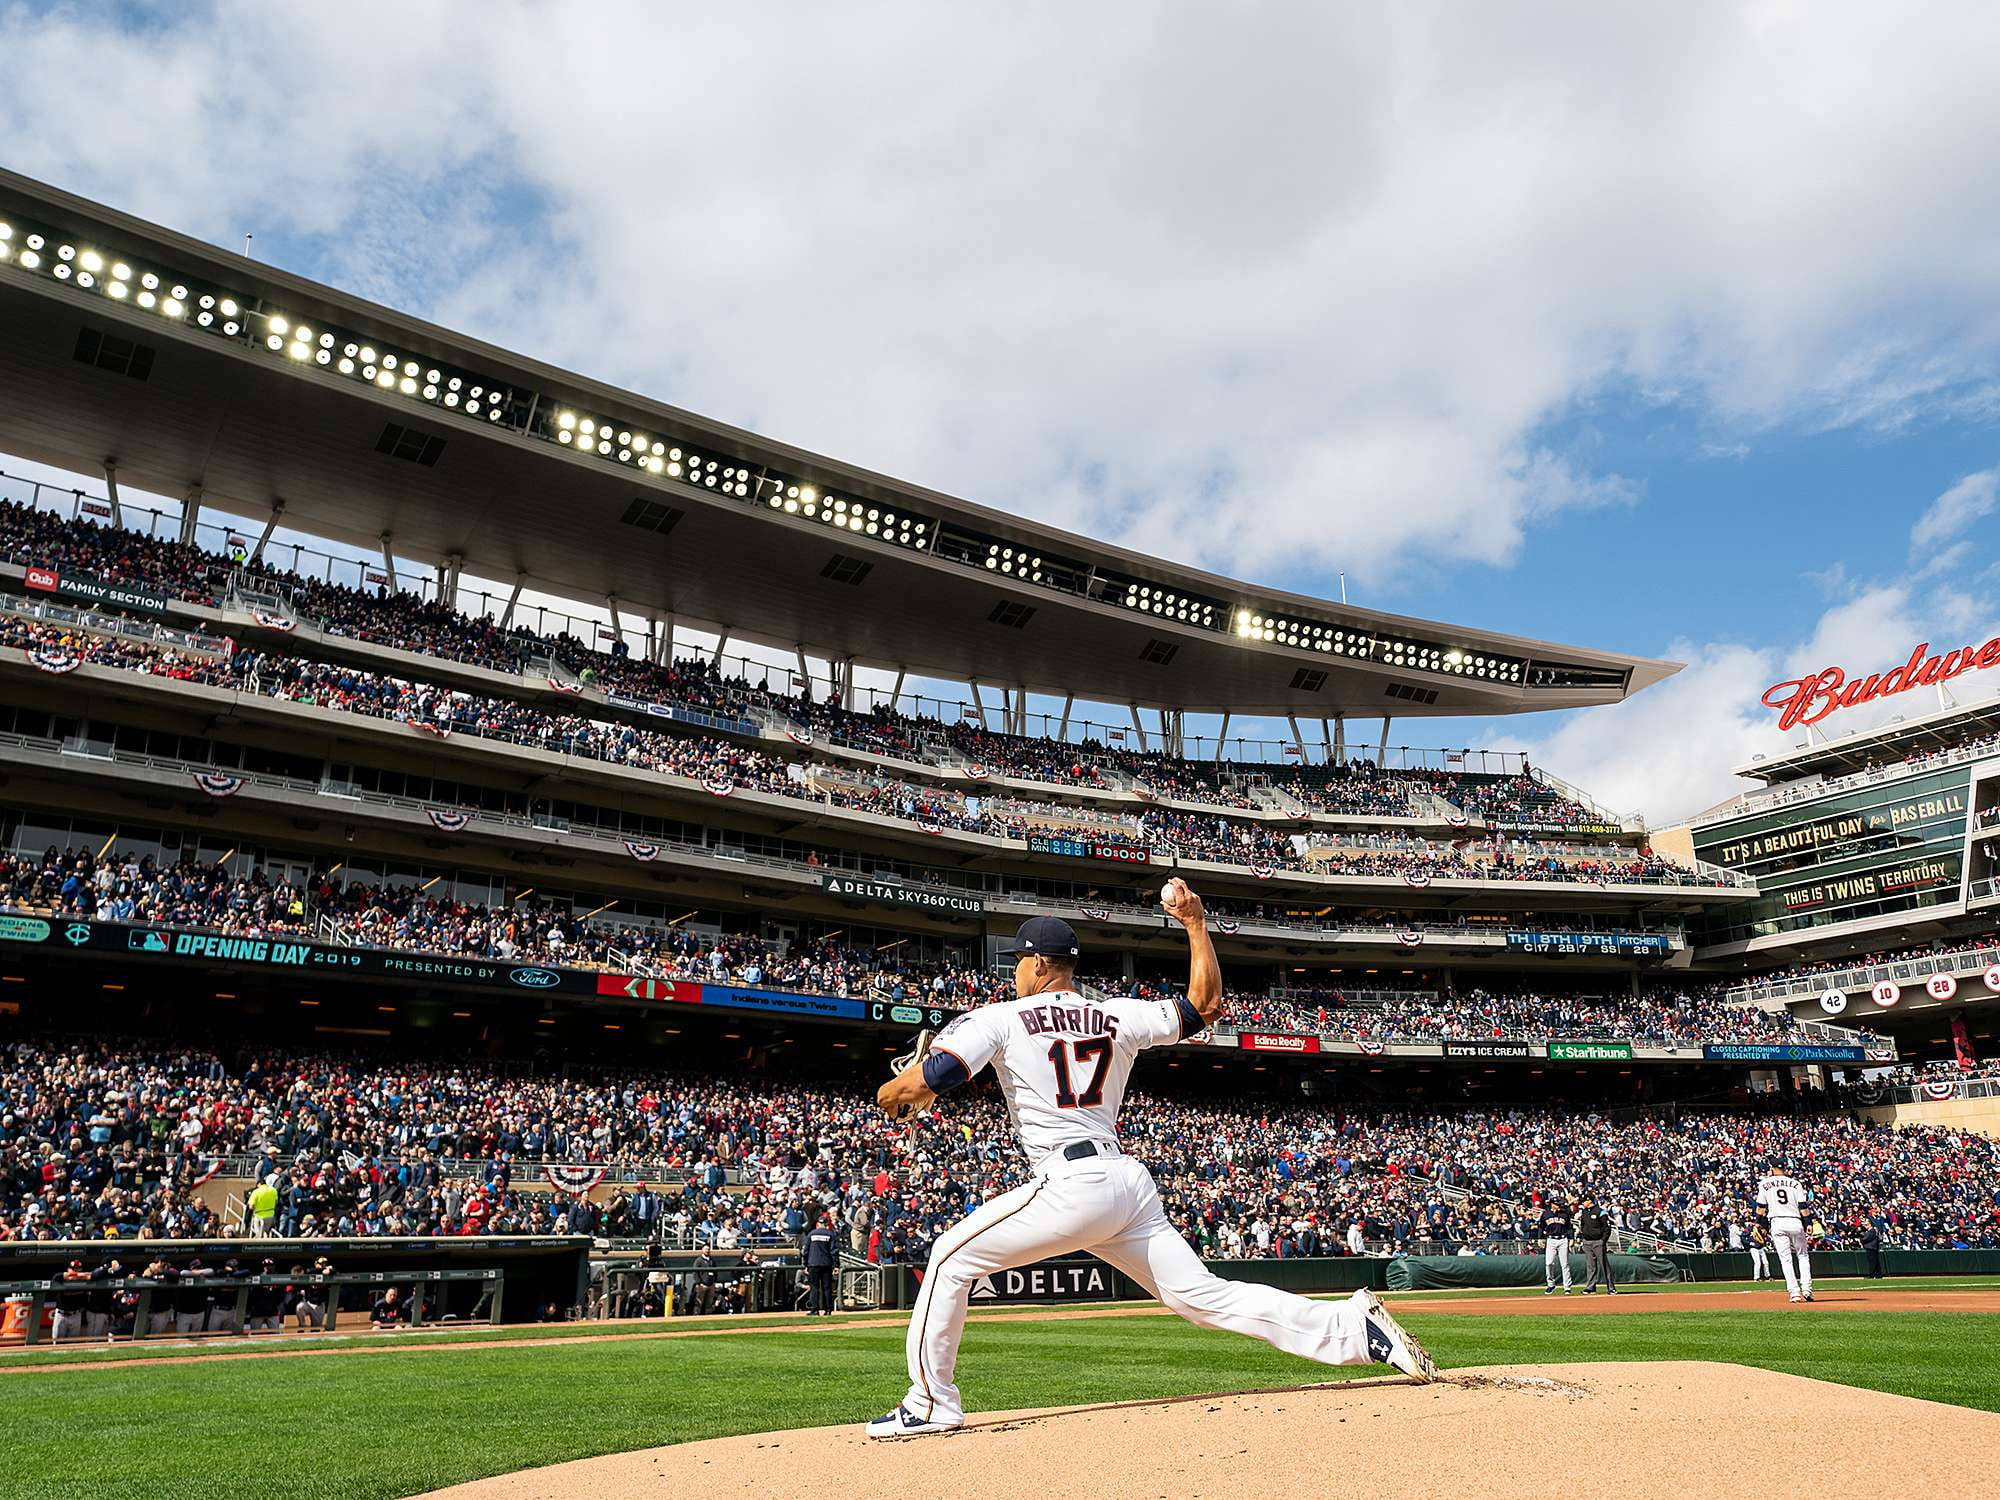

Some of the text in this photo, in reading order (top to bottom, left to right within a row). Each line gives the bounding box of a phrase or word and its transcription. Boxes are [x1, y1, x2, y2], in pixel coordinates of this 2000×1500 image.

[29, 573, 54, 586] Cub
[60, 580, 164, 610] FAMILY SECTION
[1496, 821, 1516, 831] Report
[1517, 822, 1542, 832] Security
[1722, 795, 1964, 863] IT'S A BEAUTIFUL DAY for BASEBALL
[1031, 838, 1049, 846] CLE
[1031, 845, 1049, 853] MIN
[1783, 862, 1945, 906] THIS IS TWINS TERRITORY
[844, 881, 893, 899] DELTA
[950, 898, 980, 912] CLUB
[1540, 934, 1571, 944] 8TH
[1581, 935, 1613, 945] 9TH
[1619, 936, 1658, 946] PITCHER
[175, 933, 361, 967] OPENING DAY 2019
[1524, 944, 1649, 954] C 17 2B 7 SS 28
[385, 959, 496, 979] PRESENTED BY
[519, 970, 549, 985] Ford
[1879, 987, 1892, 1000] 10
[1933, 981, 1949, 993] 28
[731, 994, 838, 1011] Indians versus Twins
[1826, 995, 1841, 1008] 42
[872, 1004, 883, 1021] C
[1254, 1035, 1305, 1048] Edina Realty
[1477, 1047, 1492, 1056] ICE
[1493, 1047, 1527, 1056] CREAM
[1565, 1046, 1627, 1059] StarTribune
[1722, 1052, 1761, 1060] PRESENTED
[1738, 1046, 1780, 1054] CAPTIONING
[1805, 1048, 1855, 1059] Park Nicollet
[1047, 1035, 1113, 1108] 17
[1776, 1188, 1789, 1205] 9
[1007, 1268, 1105, 1295] DELTA
